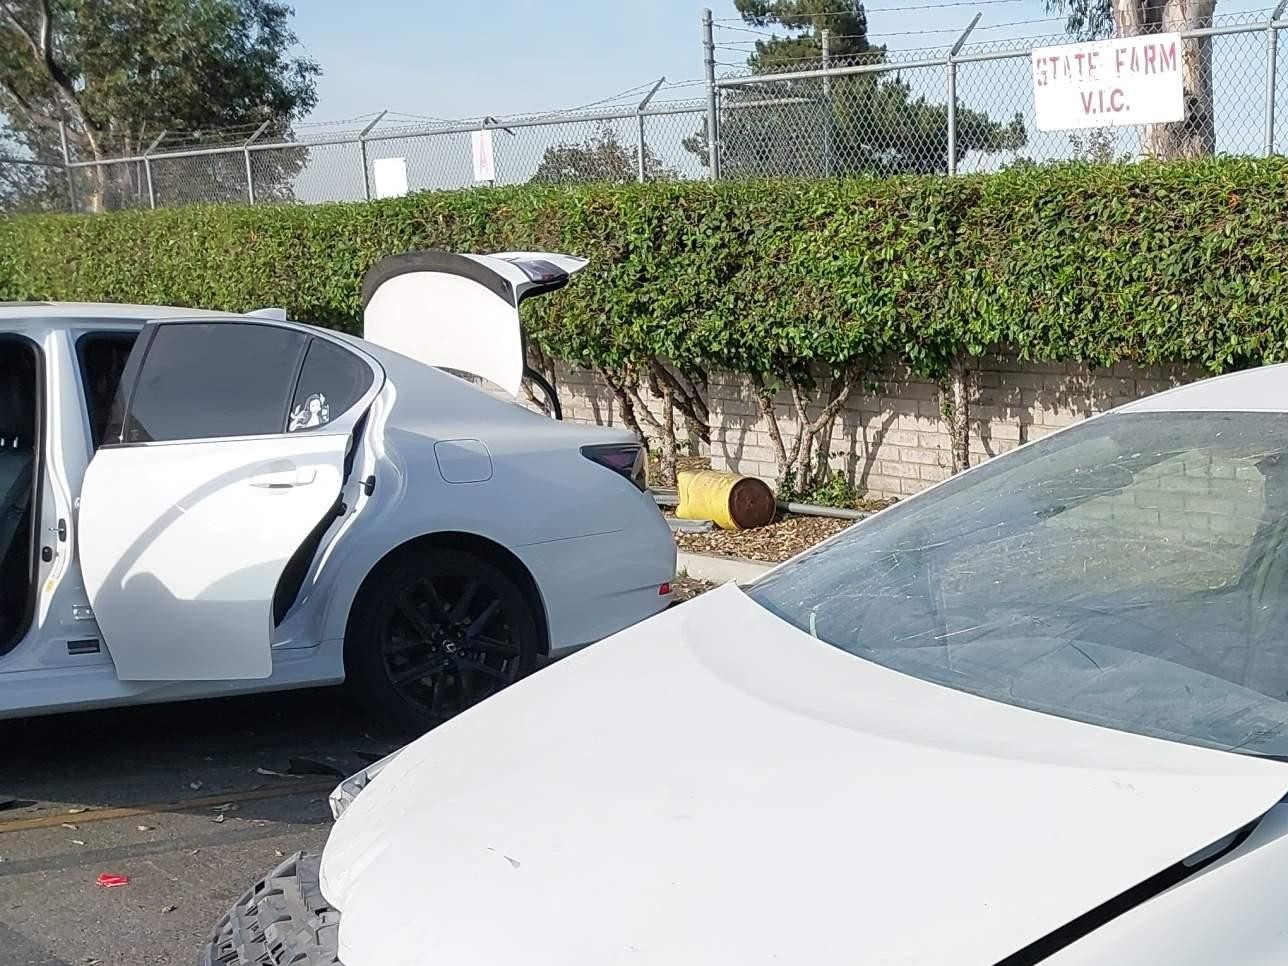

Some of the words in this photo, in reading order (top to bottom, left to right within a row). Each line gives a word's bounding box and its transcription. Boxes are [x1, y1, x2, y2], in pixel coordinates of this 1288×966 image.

[1037, 51, 1100, 86] STATE
[1116, 42, 1178, 77] FARM
[1080, 88, 1130, 115] V.I.C.
